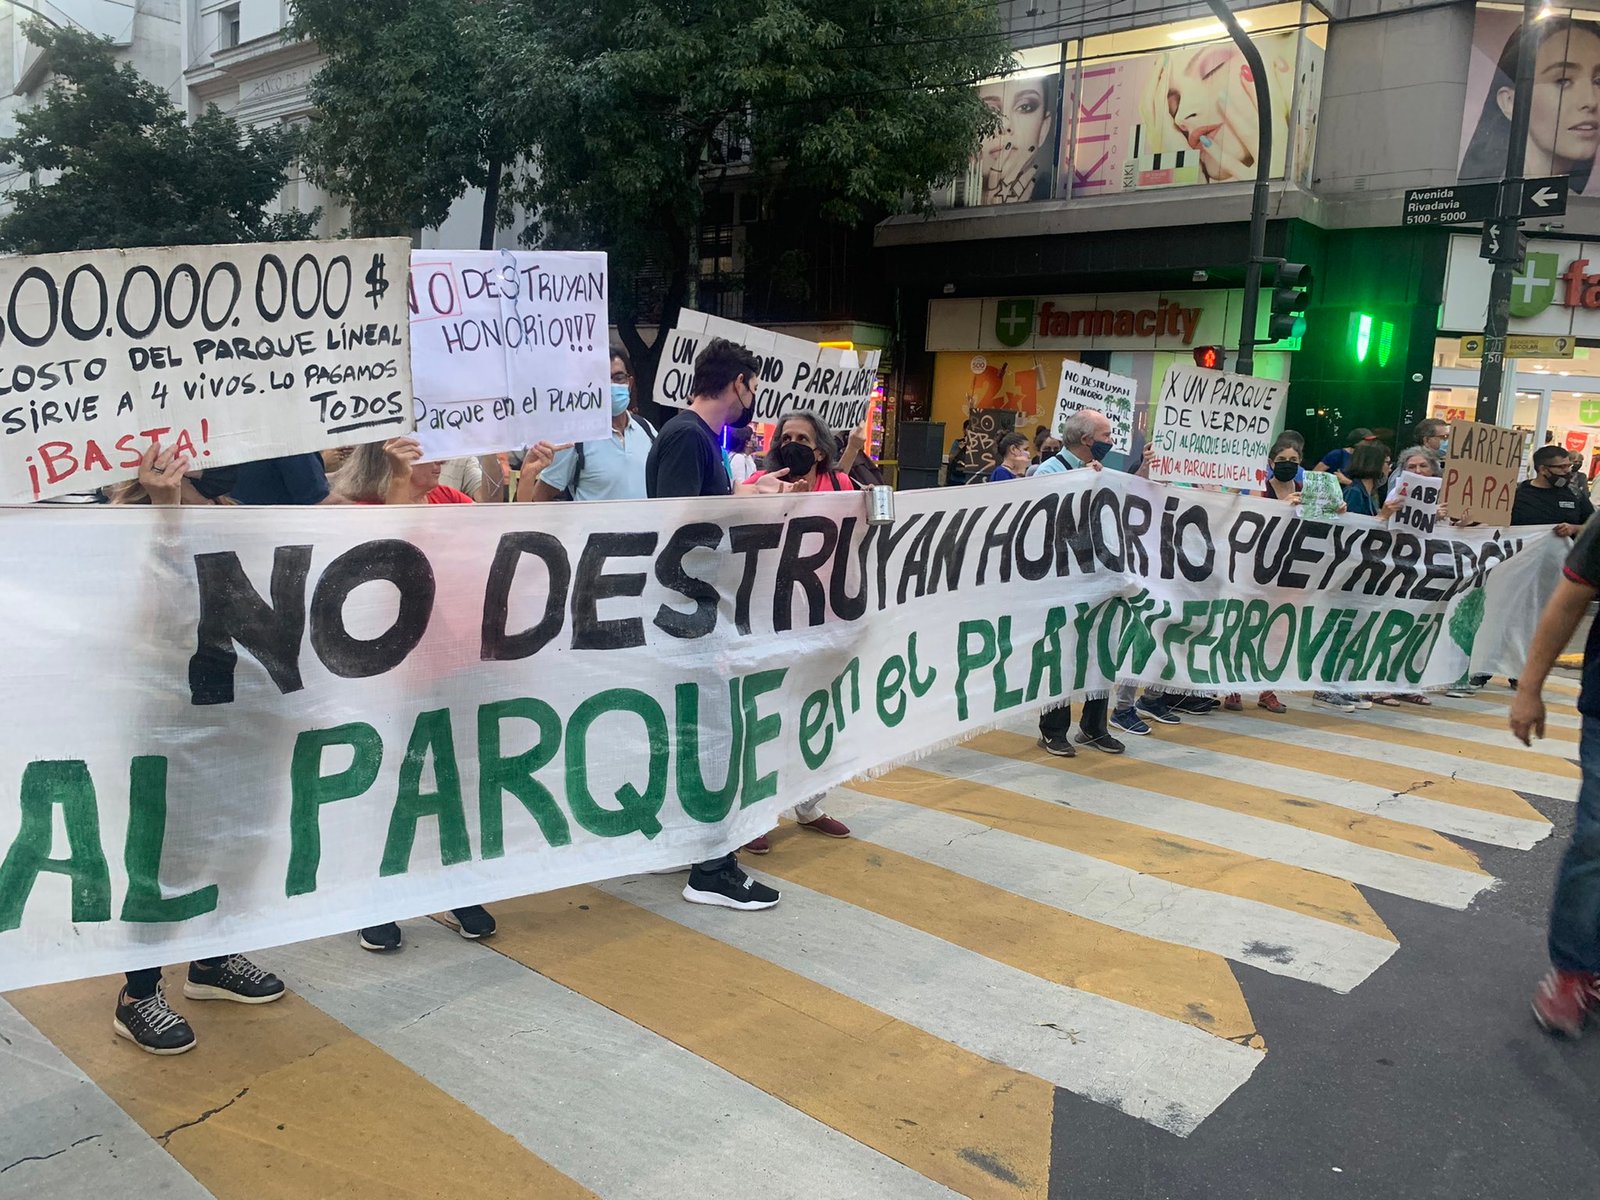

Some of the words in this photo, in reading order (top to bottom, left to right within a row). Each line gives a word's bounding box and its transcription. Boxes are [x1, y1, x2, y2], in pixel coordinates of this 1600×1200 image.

[1064, 67, 1116, 190] KIKI
[1408, 200, 1460, 212] Rivadavia
[1410, 189, 1454, 201] Avenida
[1406, 214, 1431, 224] 5100
[1440, 211, 1467, 222] 5000
[0, 254, 351, 349] 00.000.000
[365, 253, 389, 310] $
[461, 265, 605, 303] DESTRUYAN
[1037, 298, 1204, 345] farmacity
[129, 346, 183, 372] DEL
[193, 331, 317, 366] PARQUE
[672, 335, 699, 366] UN
[117, 391, 134, 417] A
[151, 380, 168, 410] 4
[270, 371, 294, 390] LO
[304, 359, 398, 388] PAGAMOS
[662, 367, 696, 402] QU
[791, 361, 843, 397] PARA
[1064, 370, 1080, 384] NO
[1081, 375, 1131, 397] DESTRUYAN
[1165, 371, 1181, 400] X
[1183, 375, 1209, 405] UN
[1210, 377, 1278, 411] PARQUE
[310, 391, 403, 424] TODOS
[493, 396, 515, 422] en
[522, 387, 538, 415] el
[547, 382, 603, 413] PLAYÓN
[1106, 412, 1121, 423] UN
[1163, 405, 1193, 428] DE
[1201, 410, 1270, 435] VERDAD
[1112, 428, 1123, 437] EL
[1188, 432, 1220, 456] PARQUE
[1221, 438, 1231, 454] EN
[1231, 439, 1241, 456] EL
[1450, 426, 1523, 469] LARRETA
[1444, 467, 1515, 513] PARÁ
[190, 538, 437, 706] NO
[481, 505, 989, 662] DESTRUYAN
[0, 755, 218, 933] AL
[285, 666, 788, 898] PARQUE
[799, 655, 861, 771] en
[876, 630, 938, 728] el
